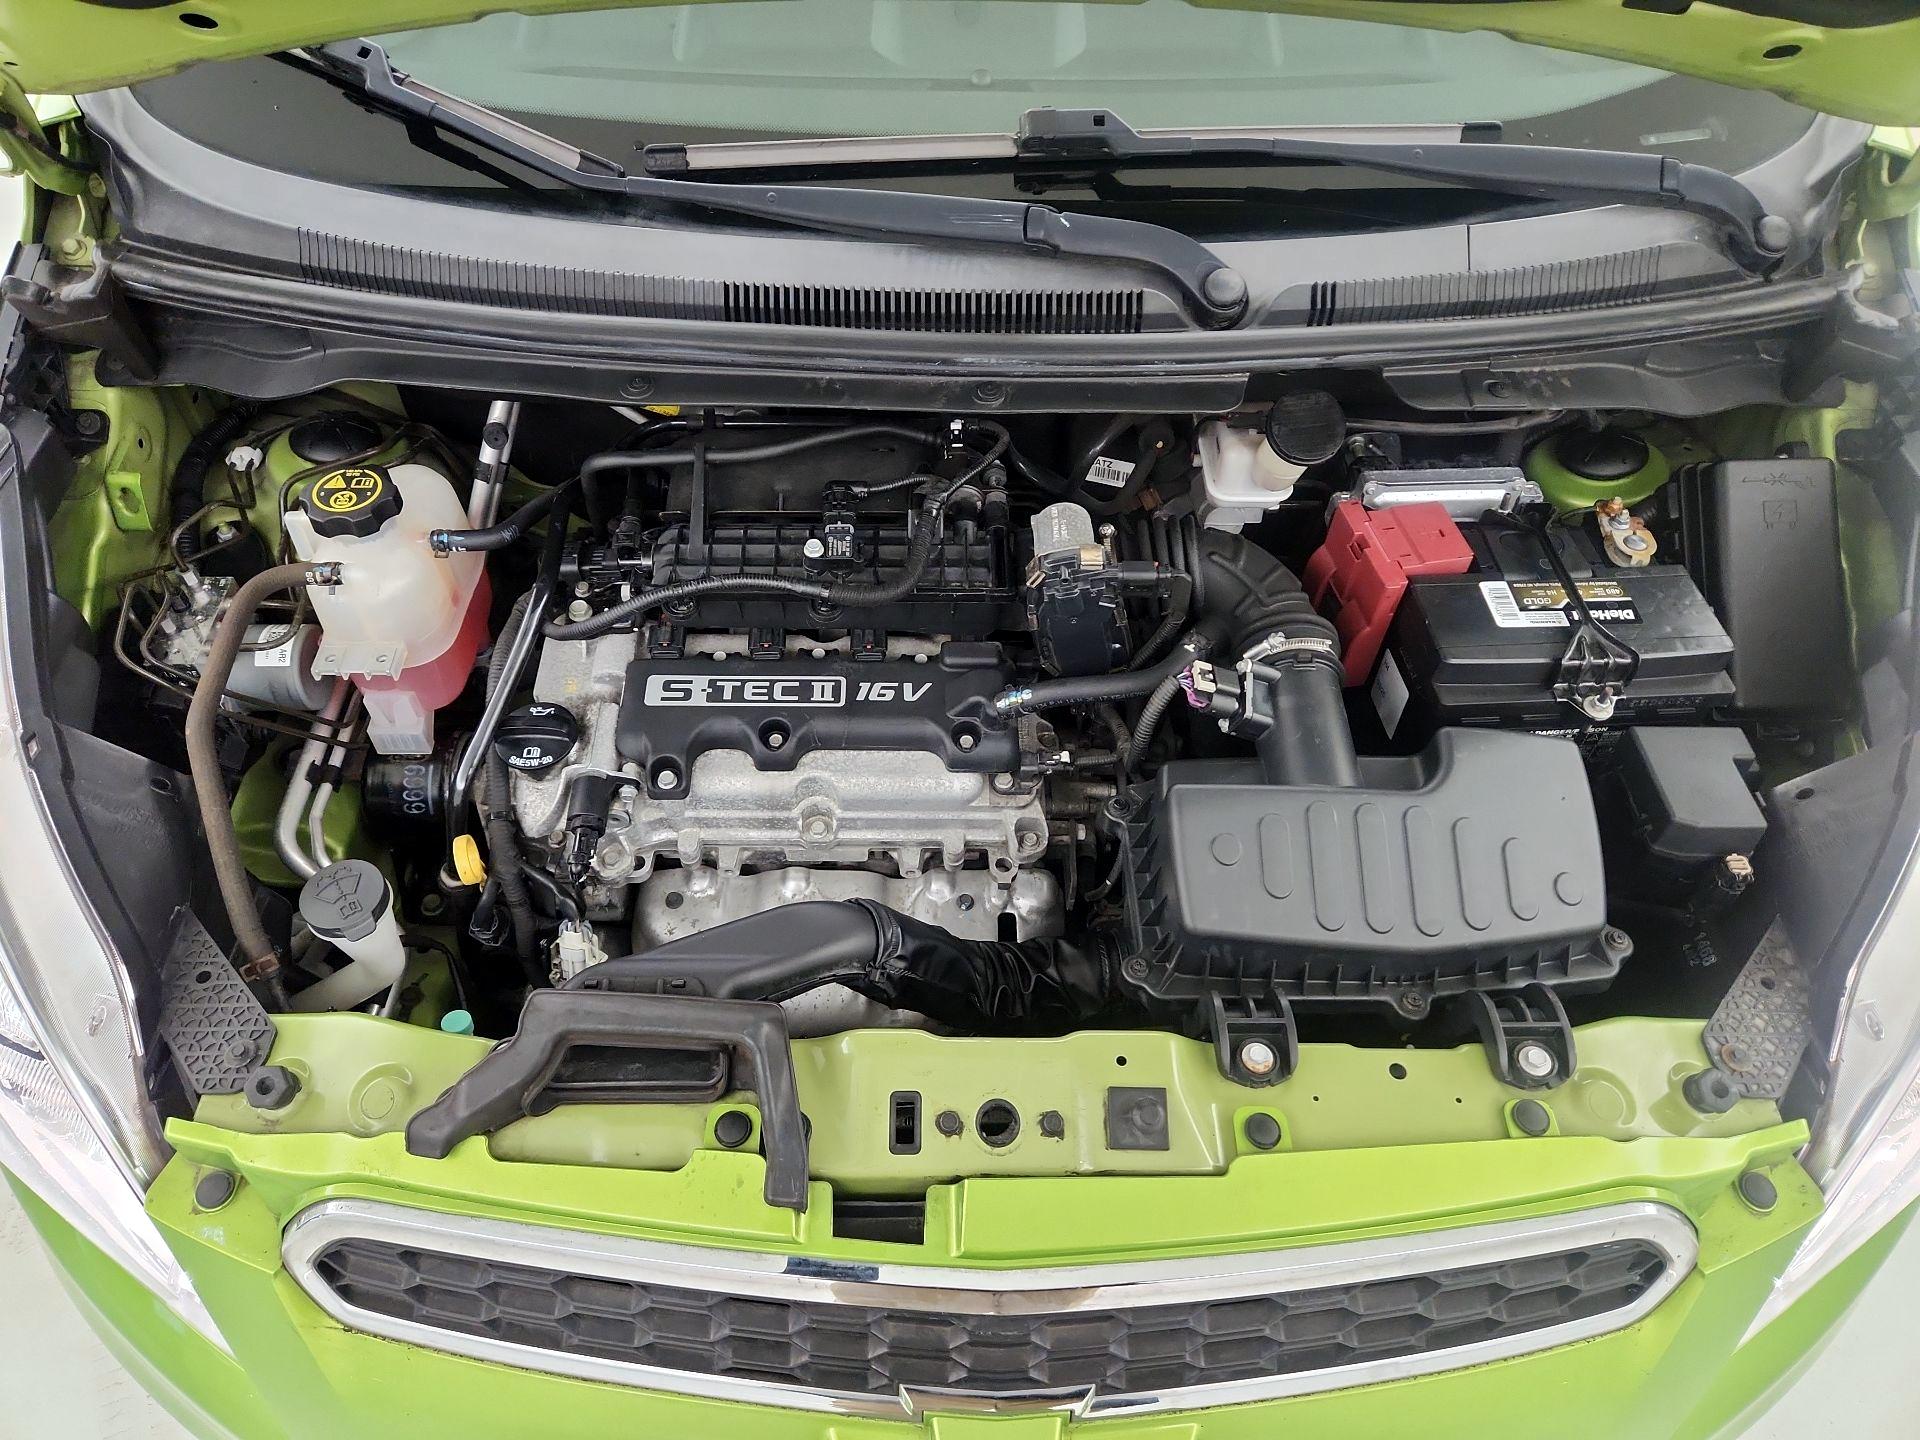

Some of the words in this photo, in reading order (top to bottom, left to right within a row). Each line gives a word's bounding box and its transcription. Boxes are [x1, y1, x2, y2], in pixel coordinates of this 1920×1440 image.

[1095, 458, 1113, 468] ATZ
[1523, 597, 1552, 605] GOLD
[1572, 609, 1636, 622] DieHa
[278, 648, 288, 663] AR2
[659, 678, 800, 702] S-TEC
[810, 681, 836, 702] II
[855, 681, 933, 702] 16V
